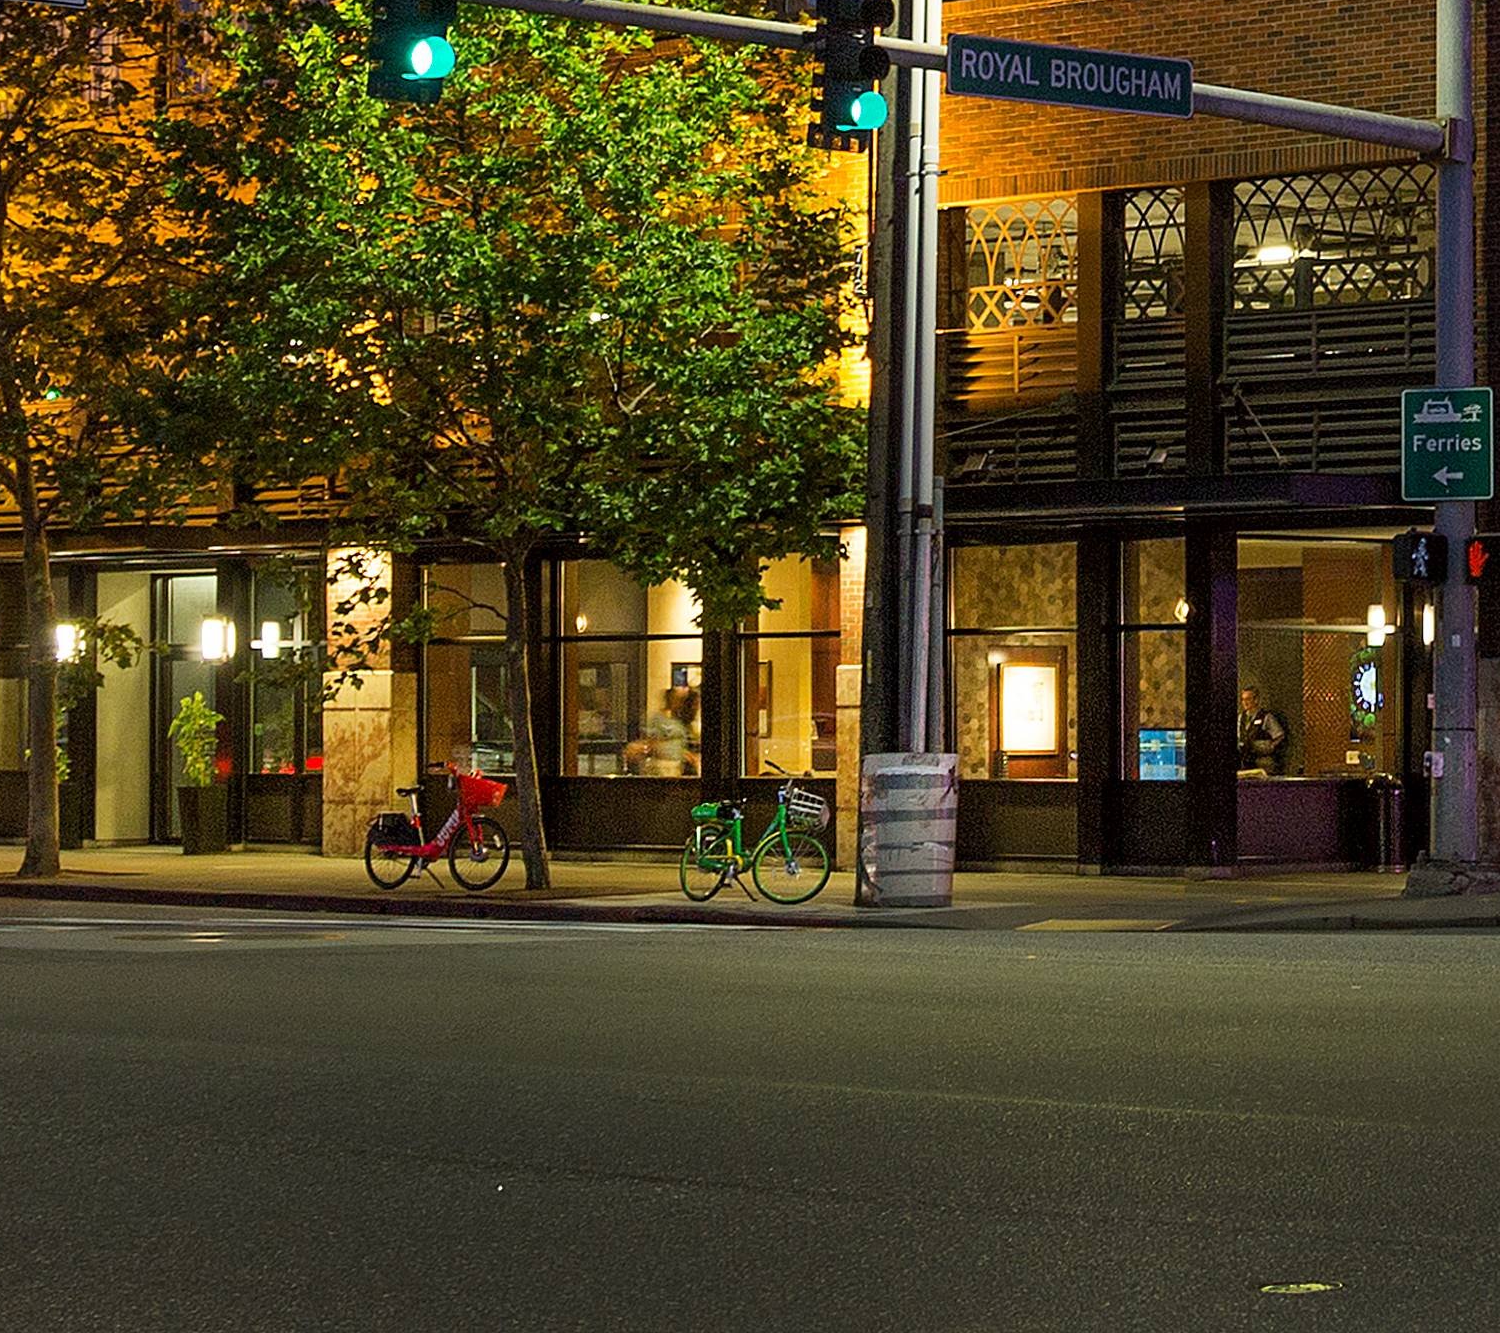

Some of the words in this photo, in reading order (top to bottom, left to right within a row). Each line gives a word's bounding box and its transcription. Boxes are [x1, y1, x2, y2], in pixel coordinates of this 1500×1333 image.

[960, 48, 1040, 87] ROYAL
[1050, 58, 1182, 101] BROUGHAM
[1412, 434, 1482, 452] Ferries
